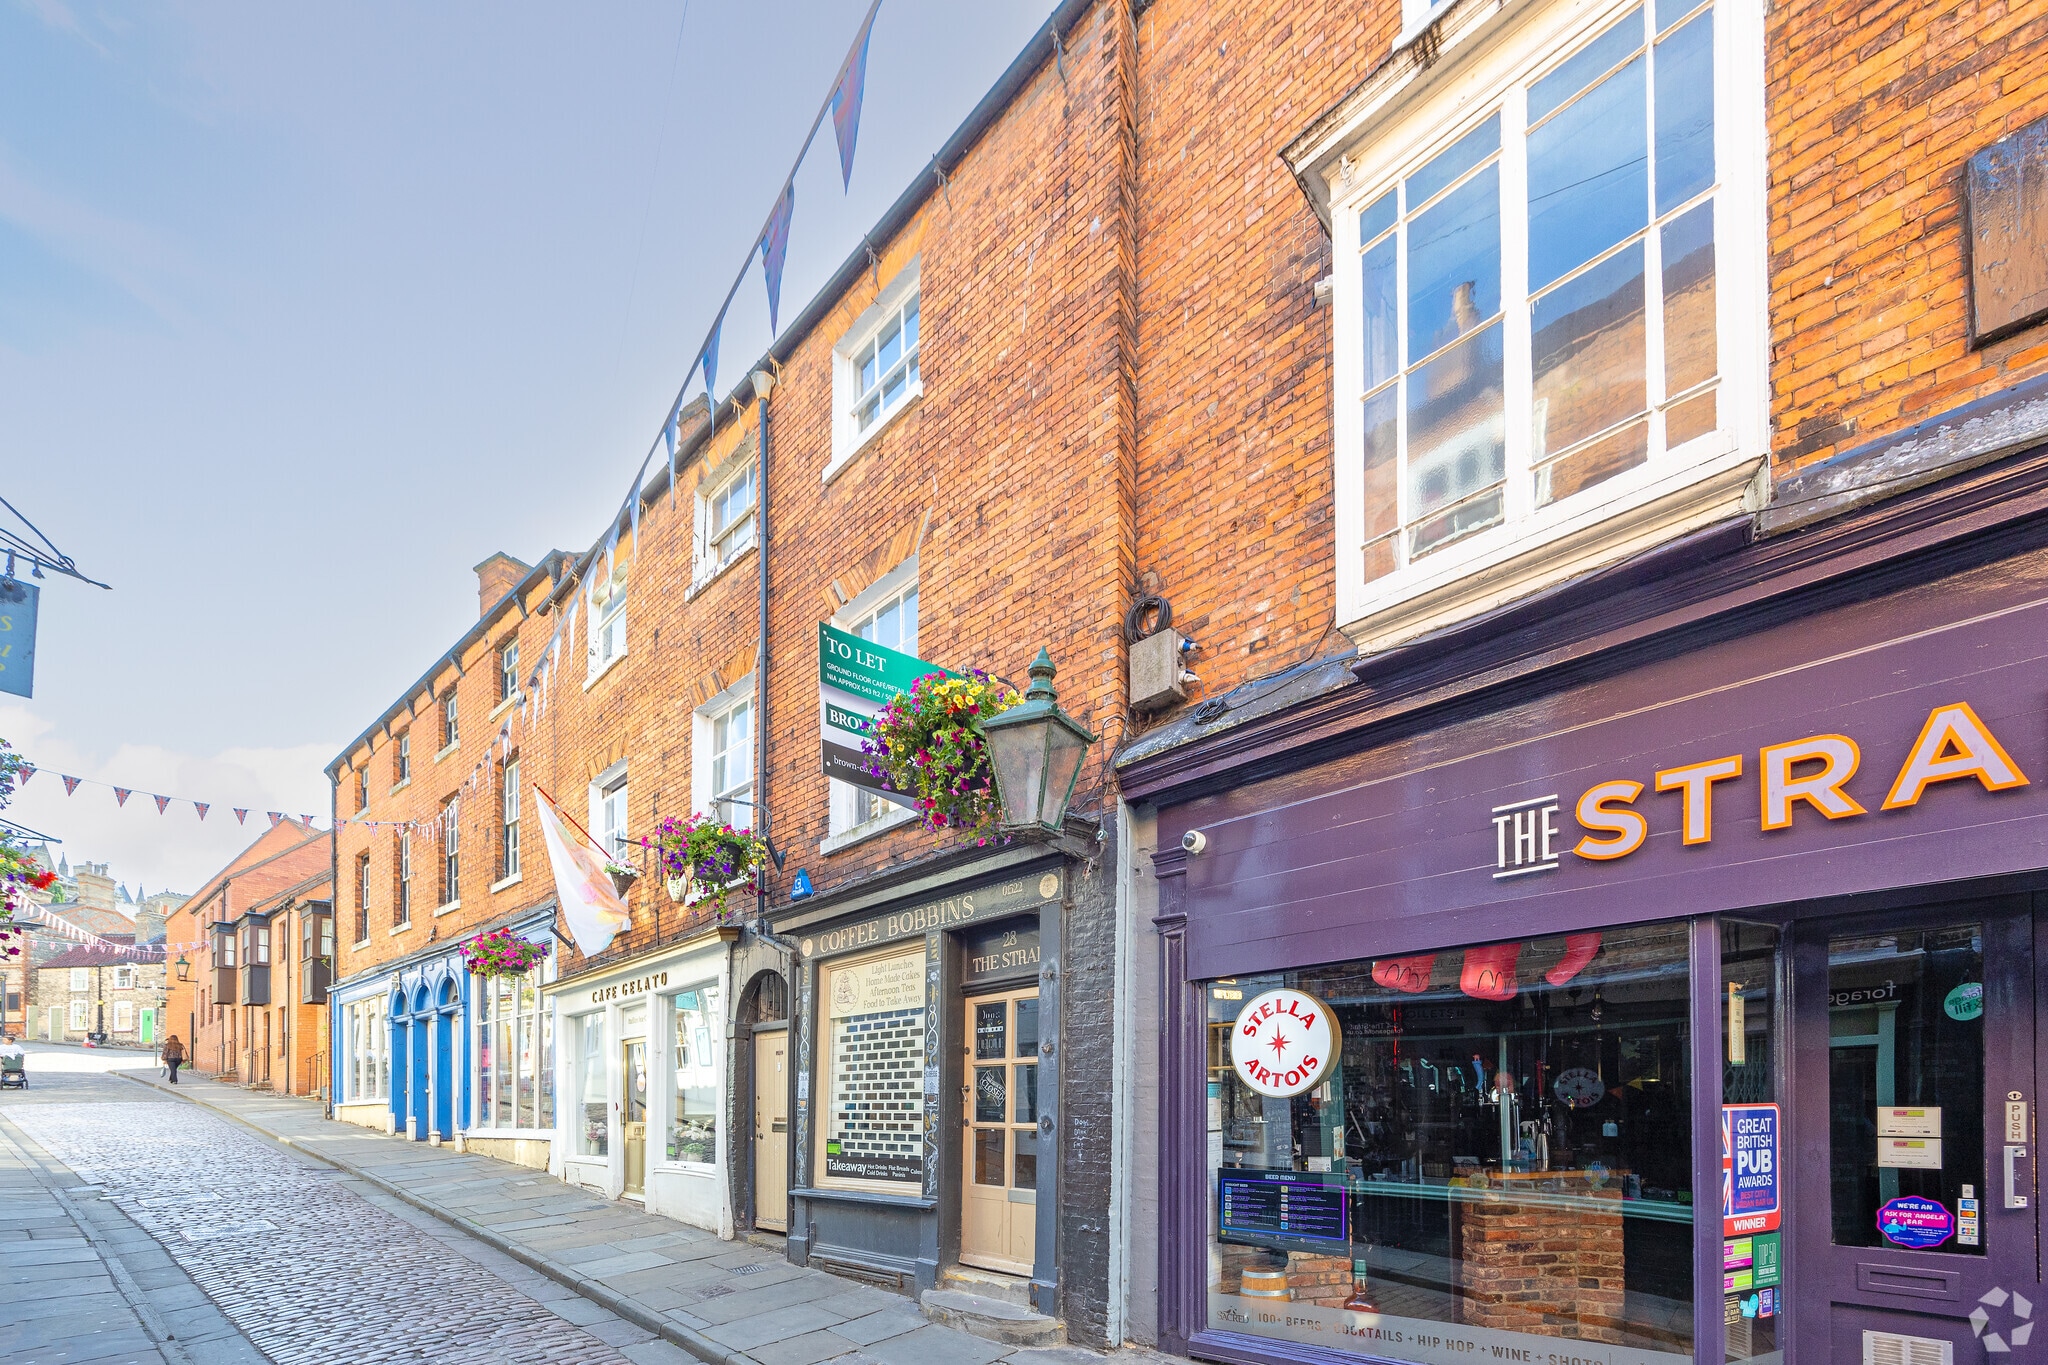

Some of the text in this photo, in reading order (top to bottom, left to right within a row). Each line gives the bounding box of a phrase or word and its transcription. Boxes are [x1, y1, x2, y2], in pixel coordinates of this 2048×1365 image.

[826, 636, 887, 672] TO LET
[826, 662, 852, 677] GROUND
[852, 672, 872, 685] FLOOR
[826, 673, 838, 682] NIA
[838, 678, 861, 691] APPROX
[861, 686, 872, 695] 543
[1492, 701, 2032, 868] THE STRA
[1097, 830, 1104, 840] 2
[819, 920, 879, 953] COFFEE
[887, 895, 975, 938] BOBBINS
[1003, 930, 1018, 948] 28
[871, 959, 914, 975] Light Lunches
[973, 954, 999, 973] THE
[592, 986, 617, 1003] CAFE
[622, 972, 668, 997] GELATO
[865, 970, 921, 987] Home Made Cakes
[869, 983, 916, 997] Afternoon Teas
[863, 994, 922, 1009] Food to Take Away
[1243, 998, 1316, 1038] STELLA
[1244, 1055, 1318, 1088] ARTOIS
[981, 1079, 1004, 1101] CLOSED
[1737, 1117, 1772, 1134] GREAT
[2011, 1104, 2021, 1139] PUSH
[1737, 1134, 1773, 1149] BRITISH
[827, 1159, 867, 1175] Takeaway
[1737, 1149, 1773, 1175] PUB
[1738, 1175, 1773, 1189] AWARDS
[1733, 1217, 1766, 1231] WINNER
[1216, 1309, 1250, 1324] SACRED
[1257, 1312, 1603, 1365] 100+ BEERS COCKTAILS HIP HOP WINE SHOT
